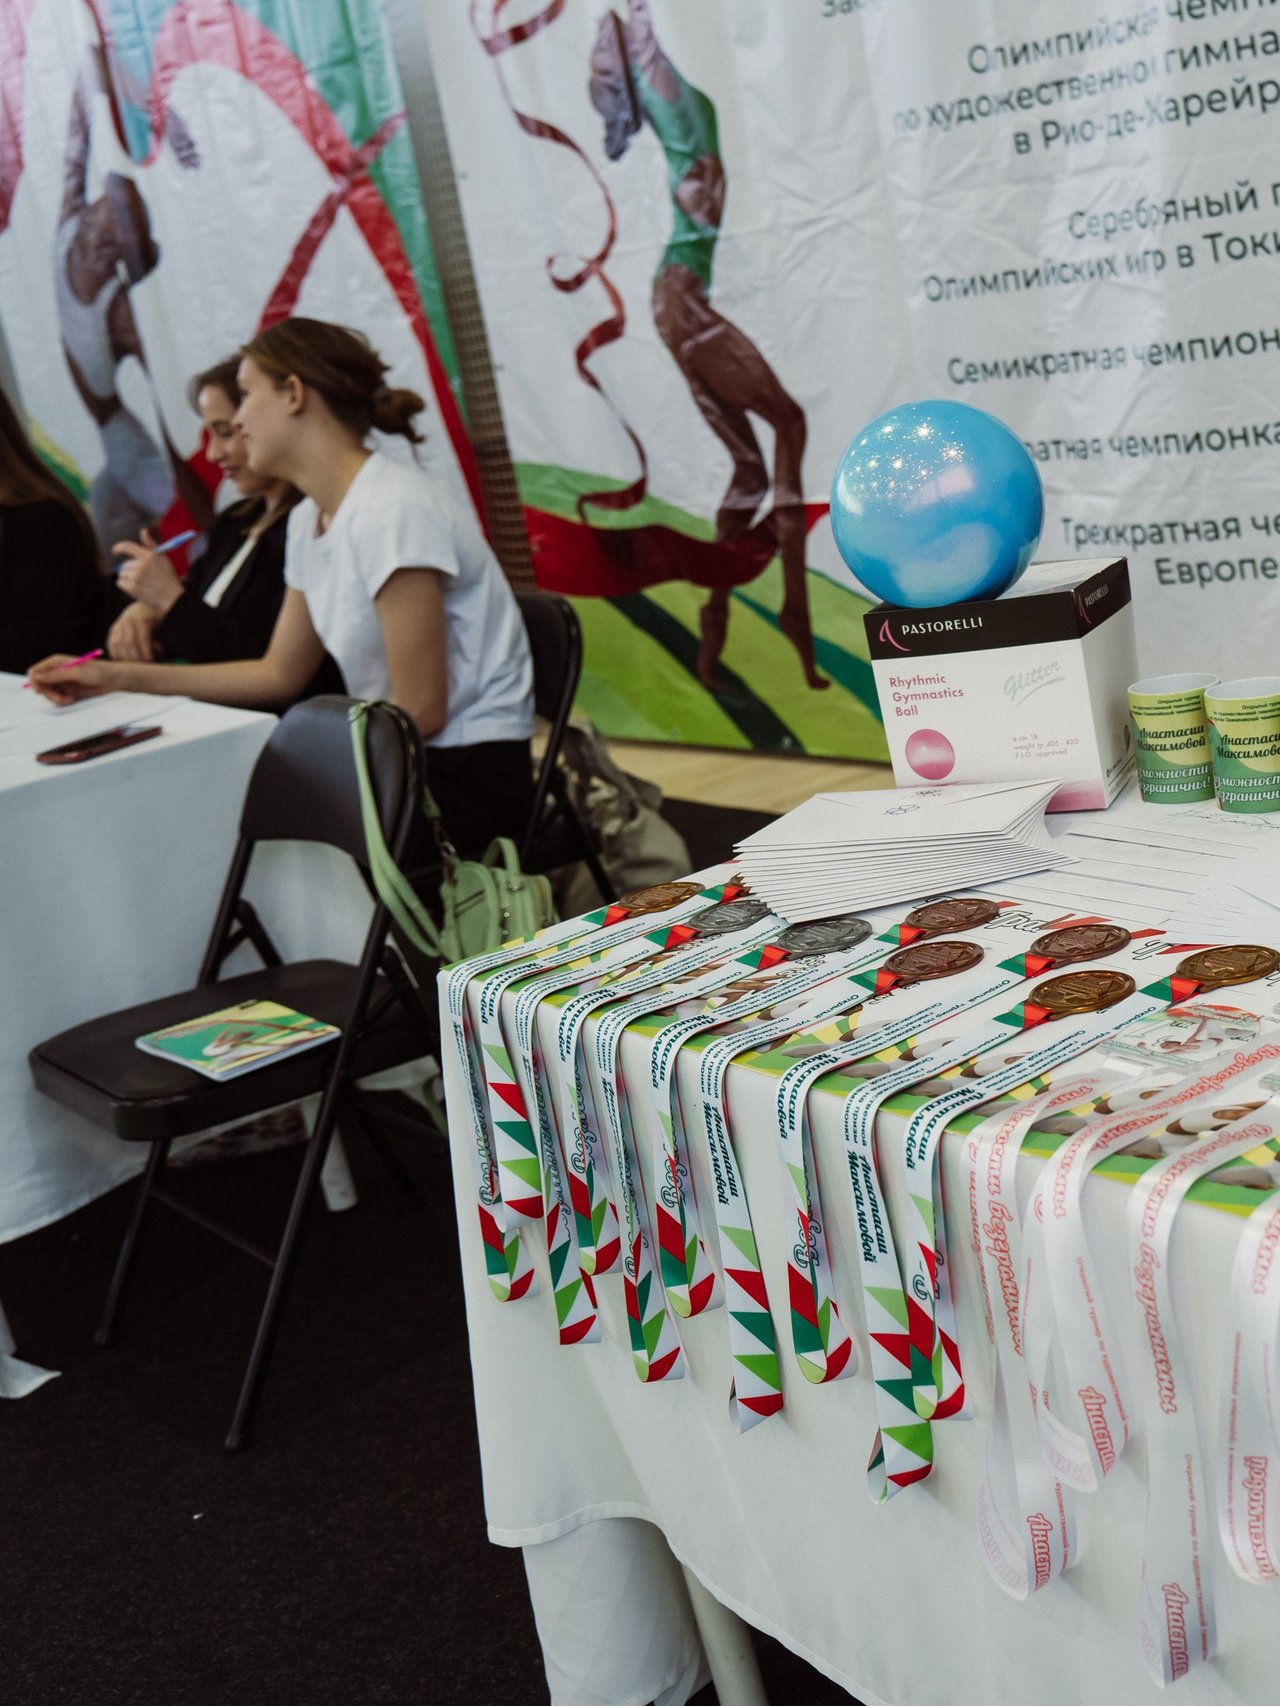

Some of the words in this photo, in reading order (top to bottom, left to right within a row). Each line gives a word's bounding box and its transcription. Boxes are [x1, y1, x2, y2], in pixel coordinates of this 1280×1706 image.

[1014, 131, 1031, 154] в
[1126, 247, 1166, 277] игр
[1177, 244, 1194, 268] в
[946, 347, 1128, 384] Семикратная
[901, 617, 983, 636] PASTORELLI
[889, 673, 946, 689] Rhythmic
[892, 686, 964, 704] Gymnastics
[1002, 660, 1061, 703] Glitter
[895, 705, 918, 717] Ball
[1139, 724, 1205, 740] Анастасии
[1030, 733, 1038, 741] 18
[1036, 748, 1068, 758] approved
[1046, 740, 1059, 748] 405
[1065, 738, 1079, 746] 420
[488, 962, 544, 1018] Анастасии
[812, 991, 859, 1020] Открытый
[557, 988, 613, 1063] Максимовой
[566, 987, 618, 1055] Анастасии
[1111, 1004, 1157, 1032] Открытый
[650, 1014, 711, 1089] Максимовой
[660, 1016, 718, 1082] Анастасии
[925, 1056, 957, 1074] турнир
[960, 1029, 1007, 1058] Открытый
[776, 1052, 832, 1140] Максимовой
[788, 1054, 842, 1131] Анастасии
[905, 1088, 976, 1171] Максимовой
[917, 1091, 987, 1162] Анастасии
[701, 1100, 730, 1206] Максимовой
[711, 1105, 739, 1198] Анастасии
[1141, 1123, 1272, 1238] Возможности
[847, 1149, 874, 1263] Максимовой
[859, 1154, 888, 1254] Анастасии
[1134, 1242, 1177, 1414] безграничны
